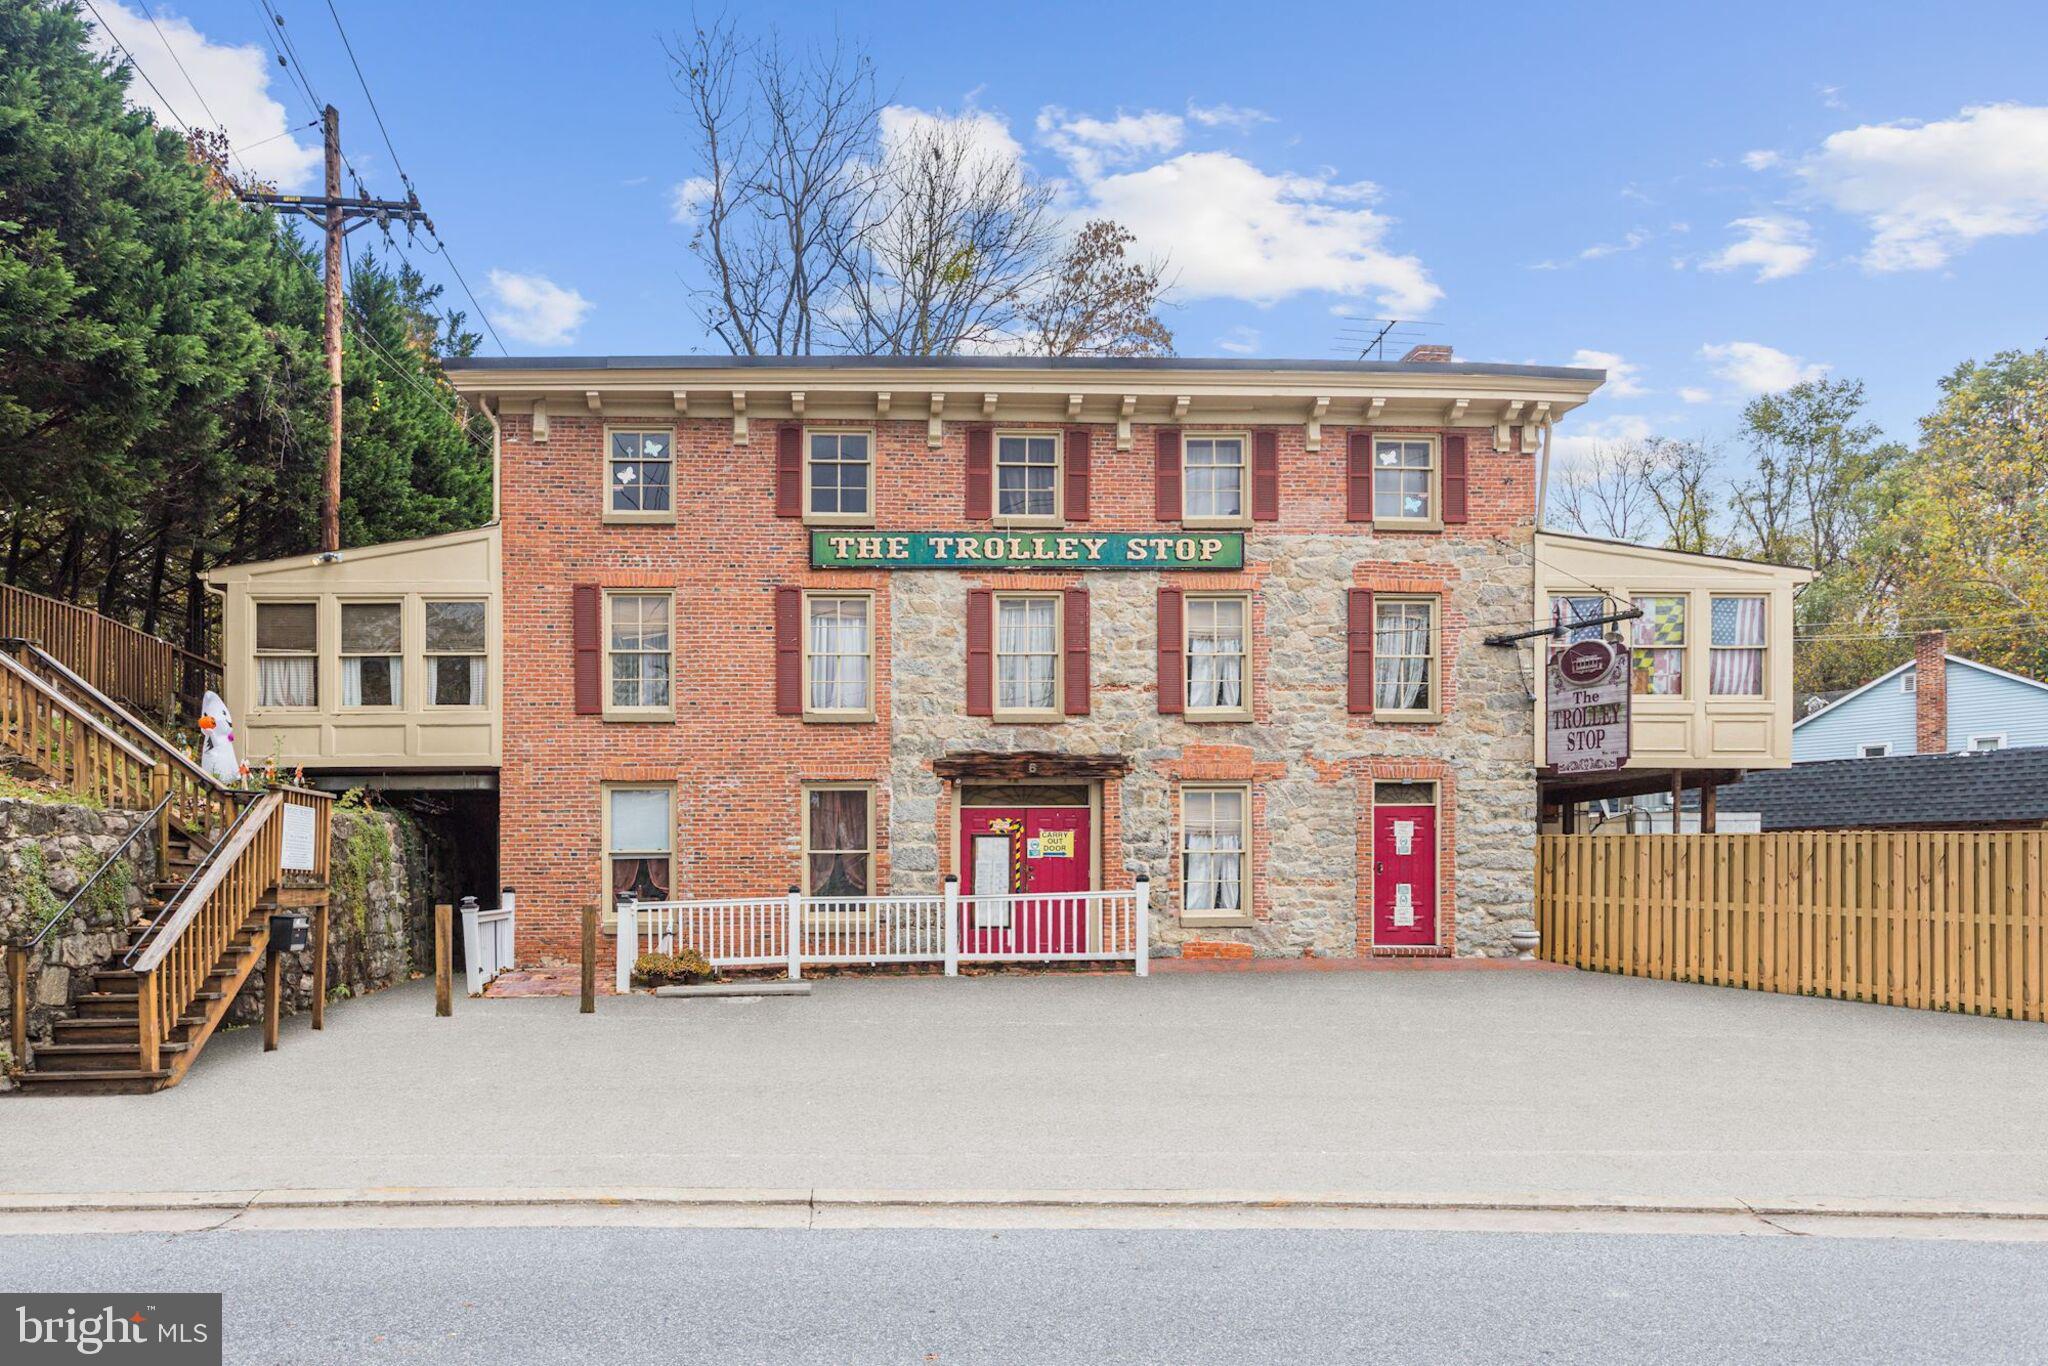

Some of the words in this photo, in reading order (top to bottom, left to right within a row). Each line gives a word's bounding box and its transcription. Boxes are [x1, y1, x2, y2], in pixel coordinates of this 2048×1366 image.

[829, 536, 909, 561] THE
[929, 537, 1107, 561] TROLLEY
[1126, 537, 1224, 561] STOP
[1573, 691, 1600, 704] The
[1553, 703, 1621, 730] TROLLEY
[1567, 729, 1605, 751] STOP
